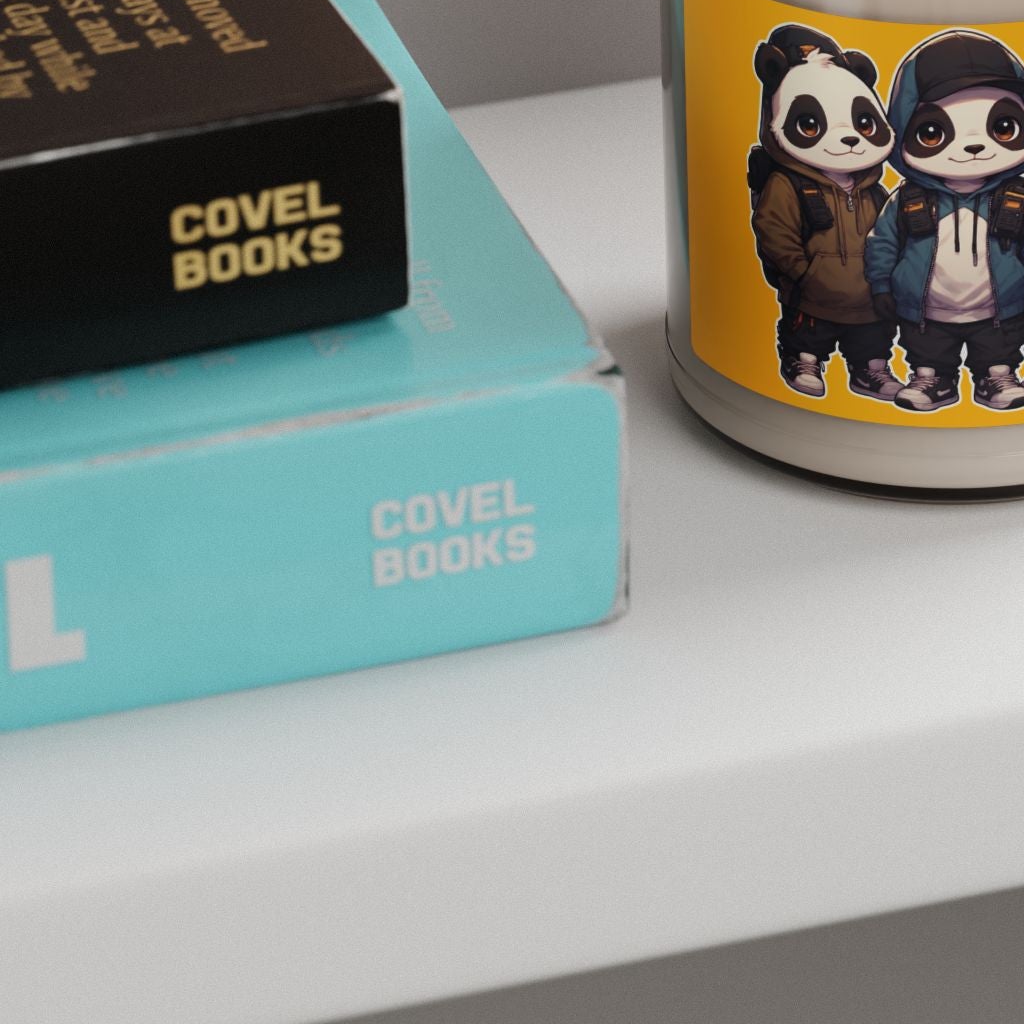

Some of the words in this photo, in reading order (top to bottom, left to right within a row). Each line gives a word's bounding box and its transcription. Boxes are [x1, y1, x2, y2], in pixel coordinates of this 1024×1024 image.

[3, 2, 53, 37] day
[75, 17, 140, 55] and
[144, 26, 192, 49] at
[169, 181, 343, 244] COVEL
[171, 224, 344, 292] BOOKS
[370, 479, 536, 540] COVEL
[372, 523, 537, 588] BOOKS
[5, 554, 87, 673] L
